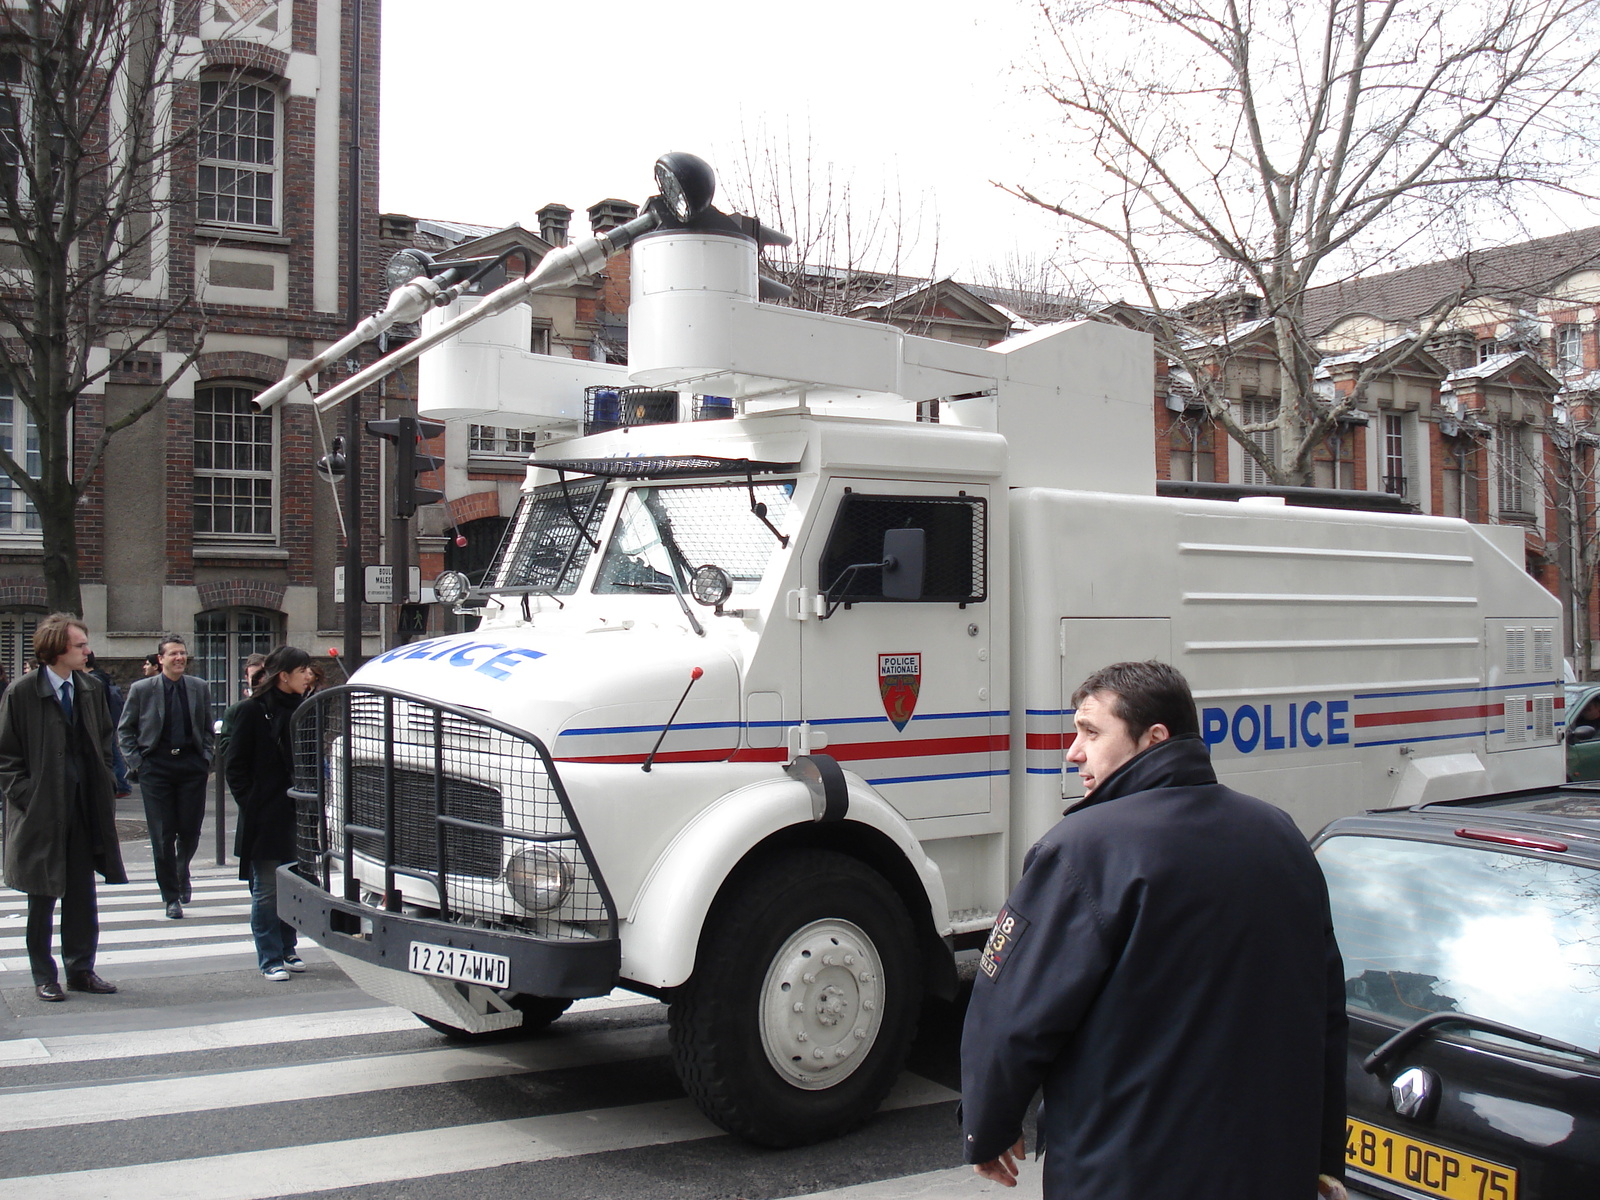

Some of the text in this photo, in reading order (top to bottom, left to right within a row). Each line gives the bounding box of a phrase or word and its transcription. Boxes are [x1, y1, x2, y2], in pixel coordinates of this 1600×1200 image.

[366, 640, 547, 681] OLICE
[881, 665, 919, 674] NATIONALE
[884, 657, 915, 666] POLICE
[1202, 700, 1349, 756] POLICE
[1404, 1144, 1460, 1192] QCP
[1470, 1163, 1509, 1200] 75
